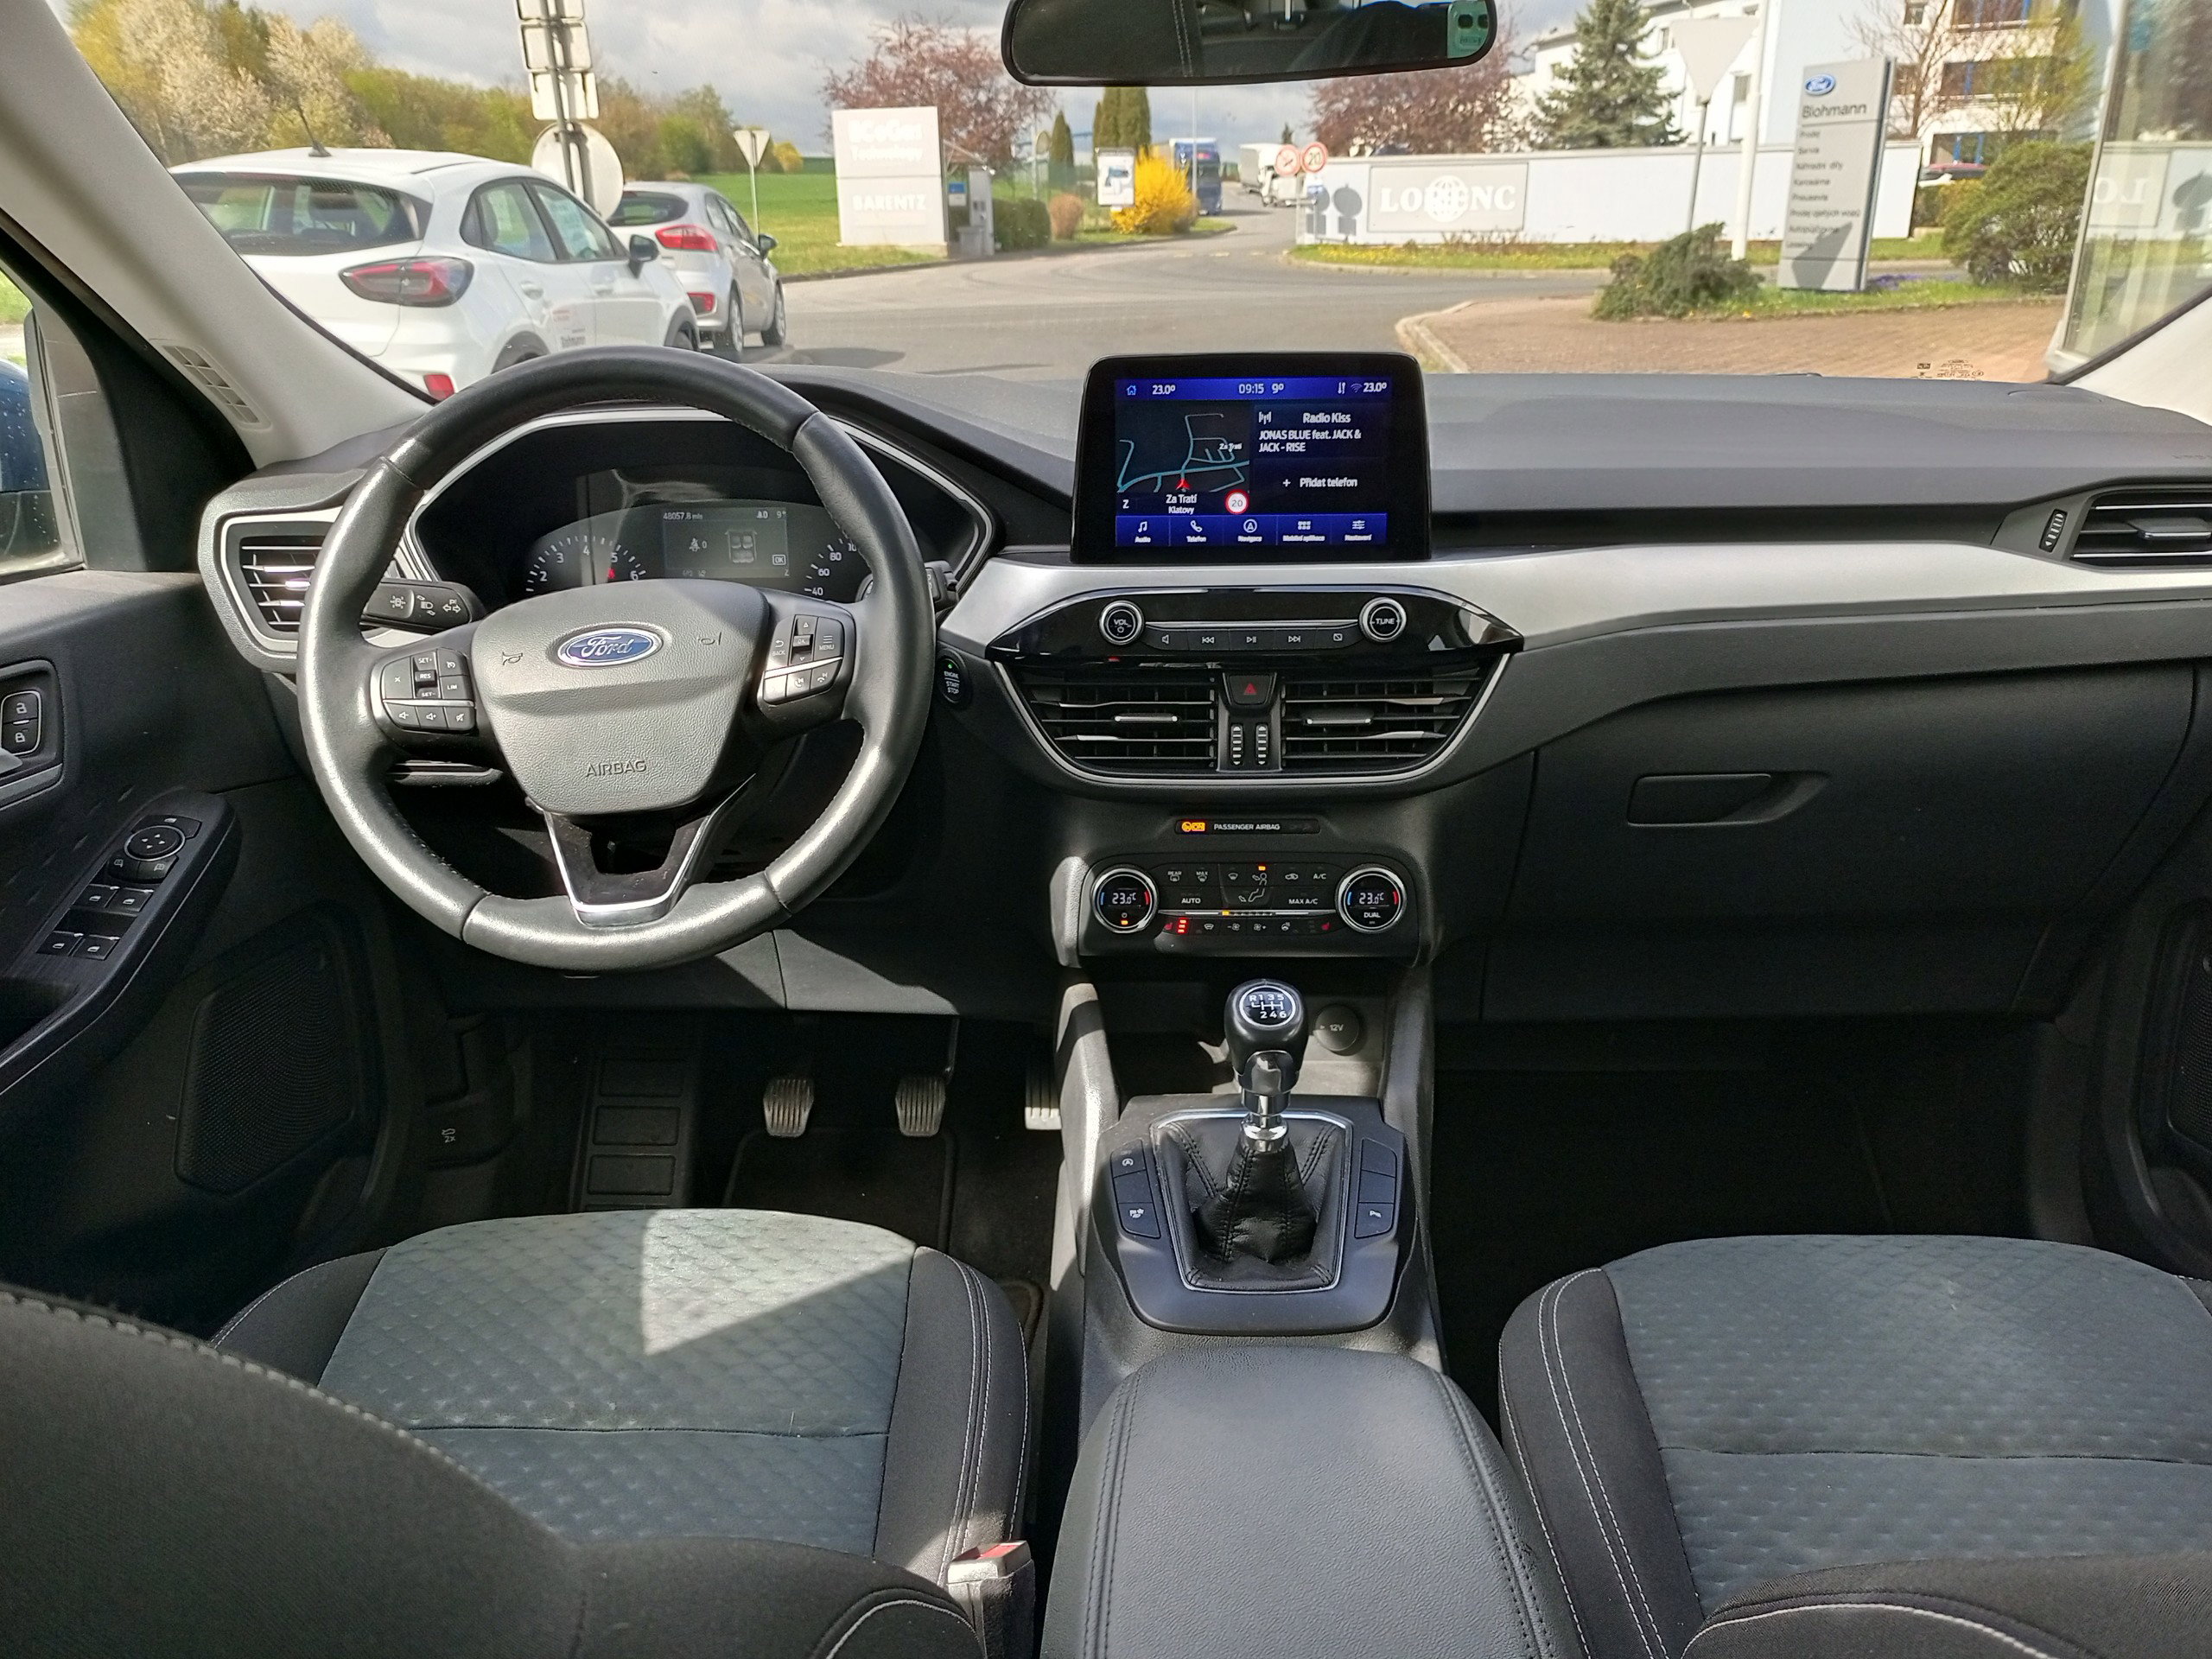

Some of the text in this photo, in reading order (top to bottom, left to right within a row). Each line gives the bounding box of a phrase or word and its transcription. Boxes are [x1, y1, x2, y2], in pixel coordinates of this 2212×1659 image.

[1307, 151, 1321, 167] 20
[852, 193, 927, 212] BARENTZ
[1238, 383, 1265, 394] 09:15
[1302, 412, 1351, 423] Radio Kiss
[1259, 429, 1362, 440] JONAS BLUE feat. JACK &
[1259, 442, 1280, 453] JACK
[1286, 442, 1306, 452] RISE
[1326, 476, 1358, 487] telefon
[1166, 494, 1198, 504] Za Tratí
[1168, 505, 1195, 515] Klatovy
[583, 545, 590, 556] 4
[556, 552, 564, 563] 3
[611, 552, 619, 563] 5
[830, 552, 842, 562] 80
[539, 570, 548, 582] 2
[630, 570, 639, 581] 6
[817, 568, 830, 576] 60
[812, 587, 823, 596] 40
[580, 635, 635, 658] Ford
[586, 760, 647, 778] AIRBAG
